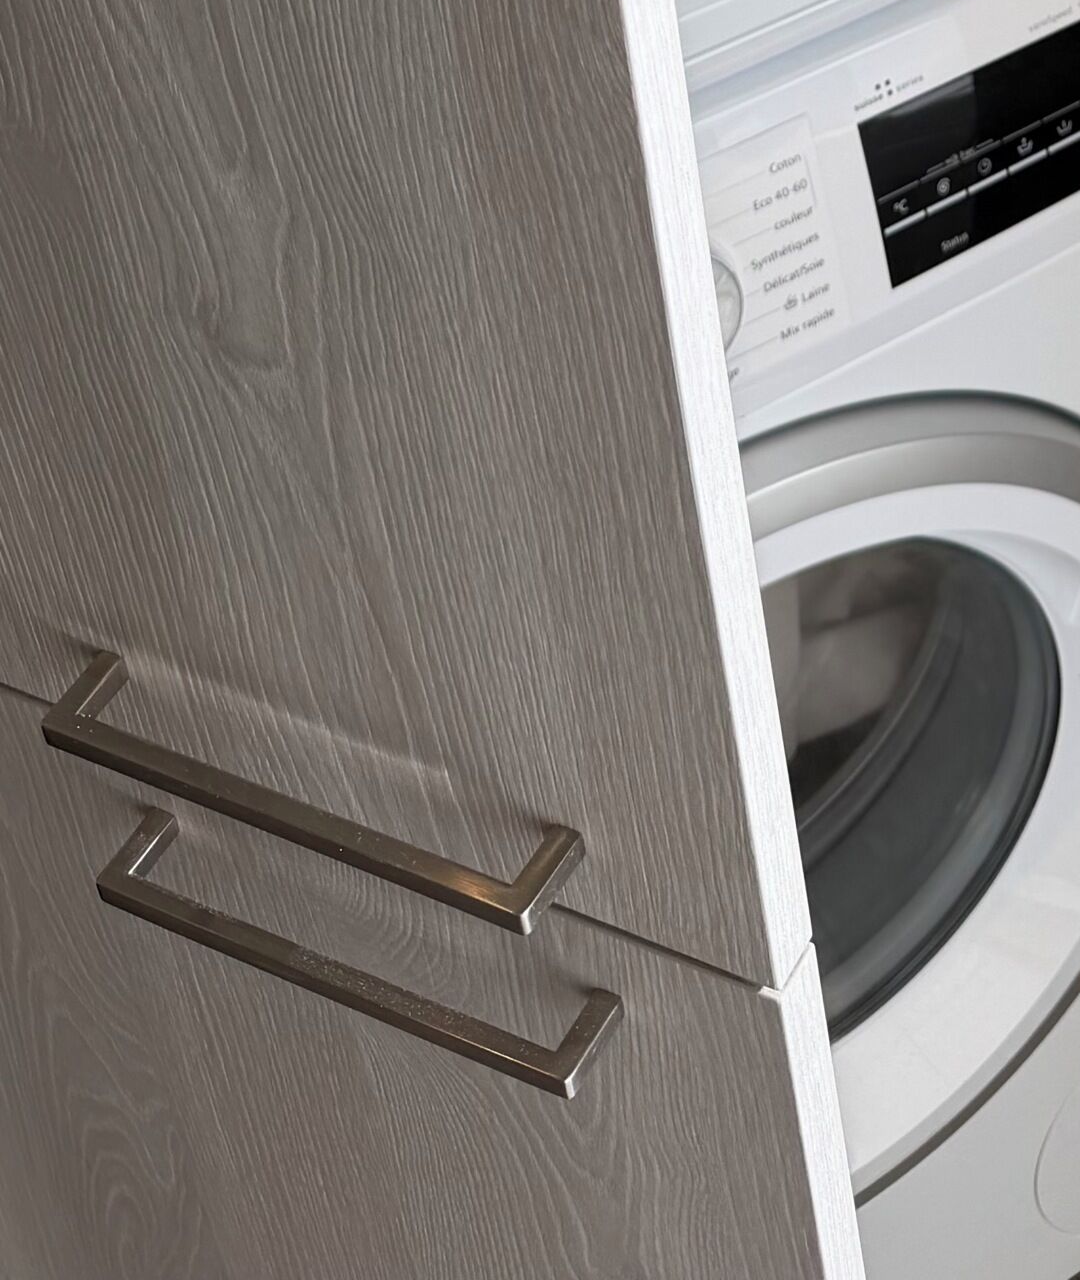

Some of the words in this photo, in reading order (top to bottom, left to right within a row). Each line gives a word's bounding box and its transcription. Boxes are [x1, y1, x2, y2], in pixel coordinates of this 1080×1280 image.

[768, 153, 802, 174] Coton
[752, 196, 773, 211] Eco
[774, 206, 813, 230] couleur
[802, 283, 831, 303] Laine
[780, 323, 801, 341] Mix
